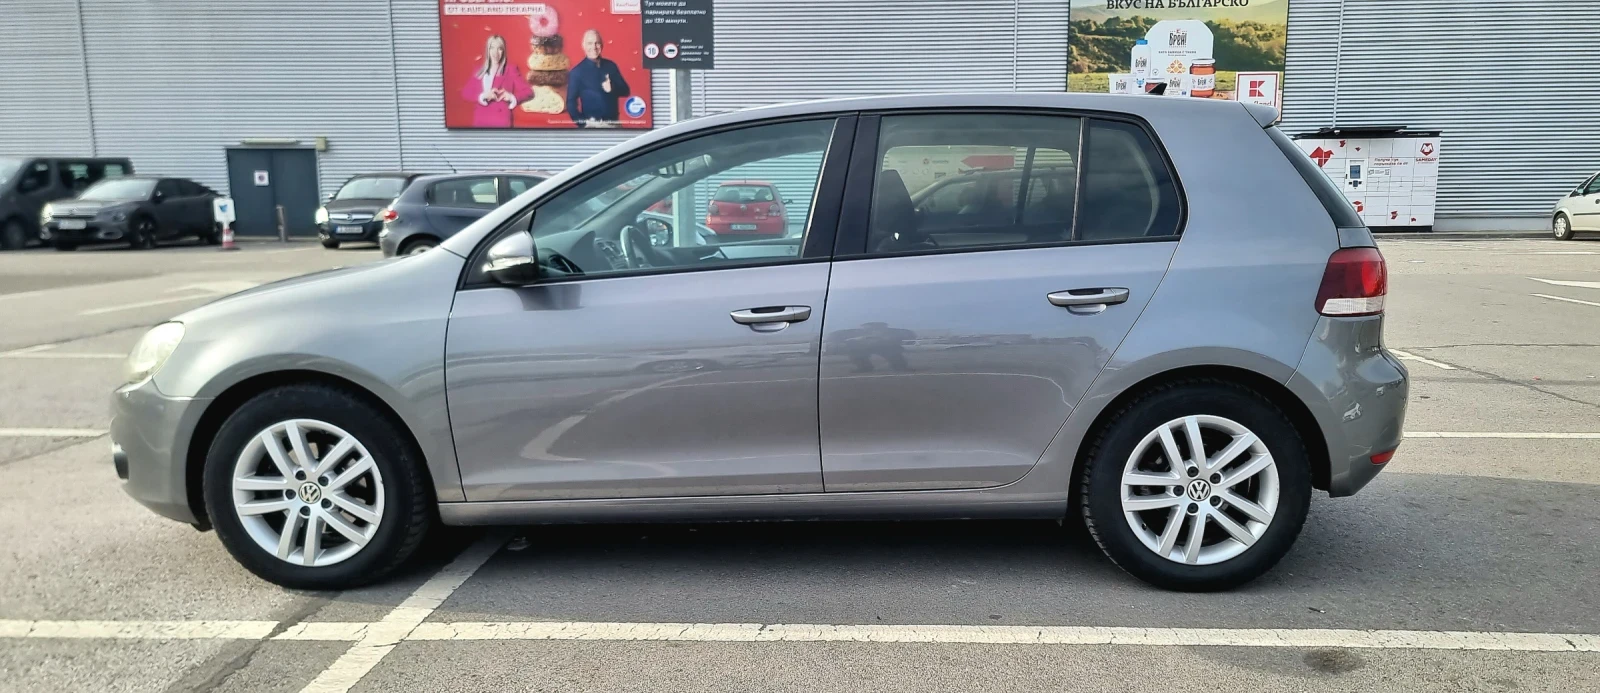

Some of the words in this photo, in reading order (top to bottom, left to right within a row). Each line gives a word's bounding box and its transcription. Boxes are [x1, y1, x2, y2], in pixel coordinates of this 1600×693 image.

[1106, 0, 1142, 9] ВКУС
[1144, 0, 1165, 9] НА
[1167, 0, 1249, 8] БЪЛГАРСКО
